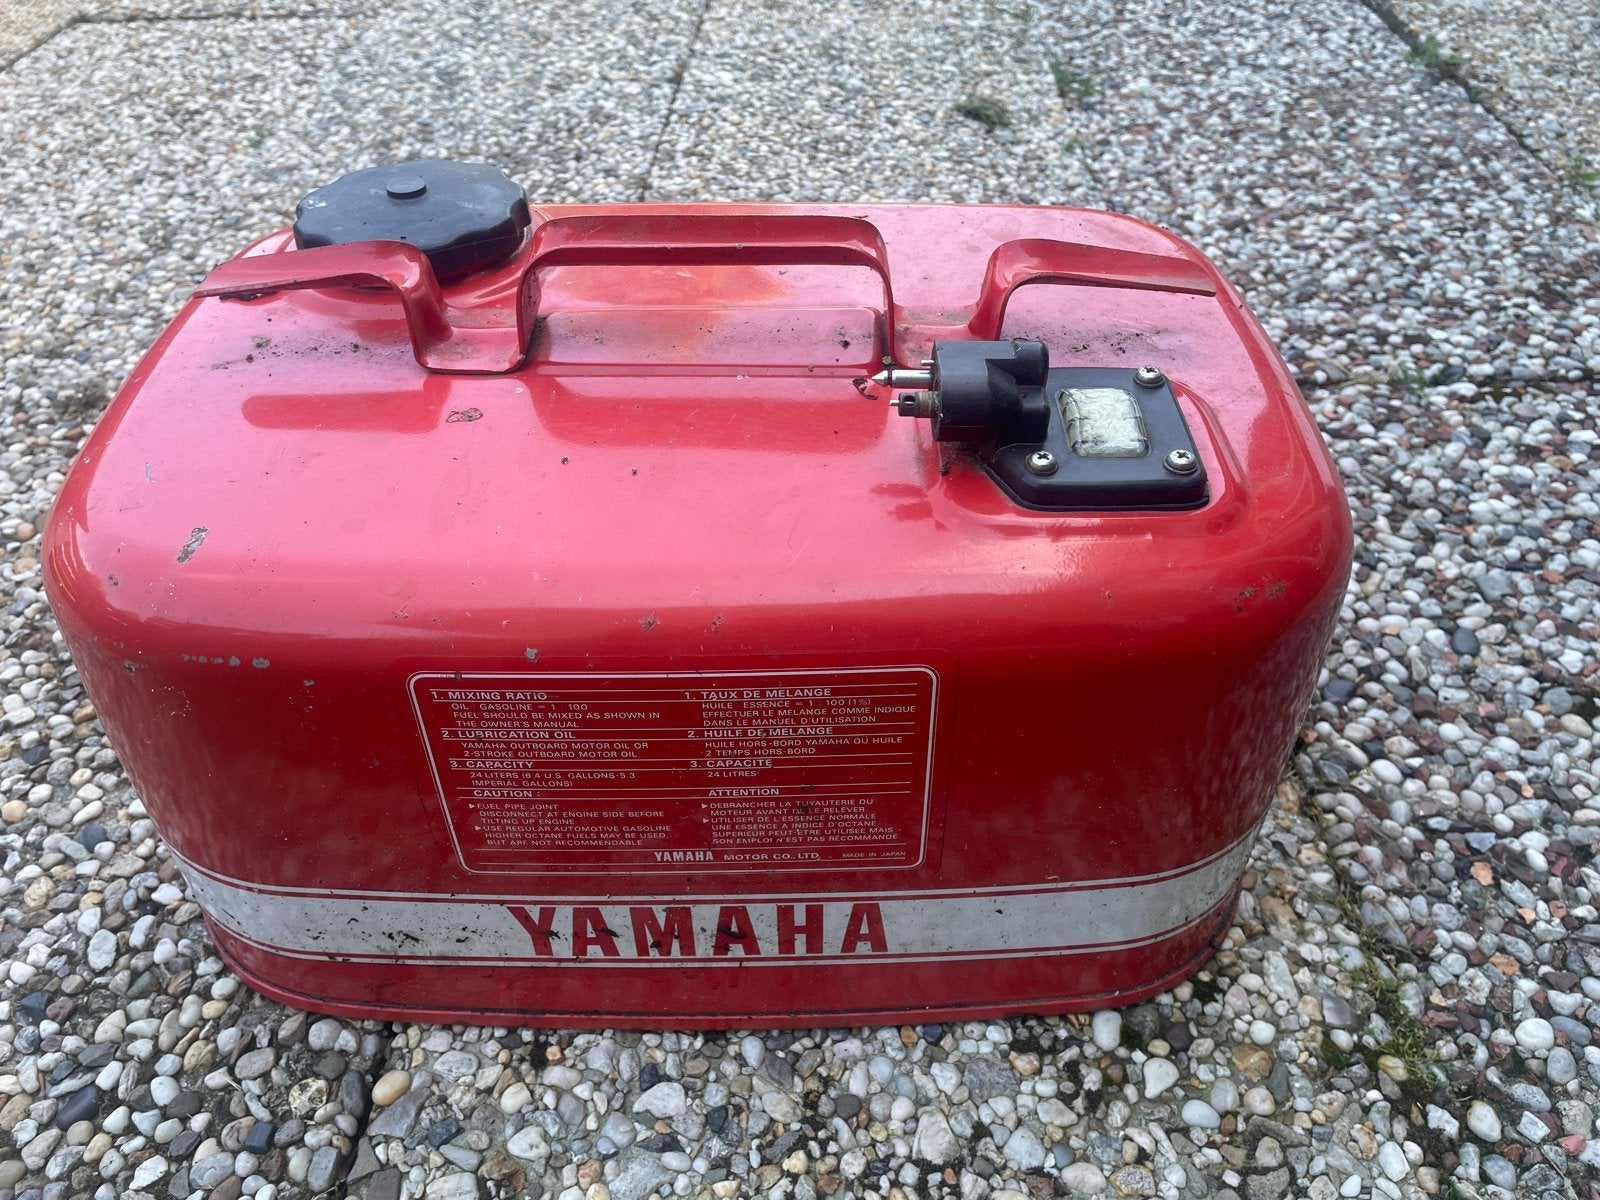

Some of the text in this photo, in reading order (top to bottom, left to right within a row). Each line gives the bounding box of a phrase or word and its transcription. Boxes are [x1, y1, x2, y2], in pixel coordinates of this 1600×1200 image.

[431, 691, 547, 700] 1. MIXING RATIO
[701, 691, 738, 699] TAUX
[743, 690, 761, 698] DE
[765, 688, 831, 698] MELANGE
[743, 700, 790, 709] ESSENCE
[848, 698, 871, 706] (1%)
[702, 710, 759, 718] EFFECTUER
[778, 708, 827, 716] MELANGE
[874, 705, 916, 713] INDIQUE
[480, 720, 530, 728] OWNER'S
[703, 719, 733, 727] DANS
[752, 718, 796, 726] MANUEL
[441, 730, 577, 739] 2. LUBRICATION OIL
[687, 727, 833, 738] 2. HUILE DE MELANGE
[805, 738, 850, 746] YAMAHA
[872, 736, 903, 744] HUILE
[510, 742, 567, 750] OUTBOARD
[571, 742, 611, 750] MOTOR
[613, 742, 631, 750] OIL
[633, 742, 649, 750] OR
[464, 750, 515, 758] 2-STROKE
[716, 749, 751, 757] TEMPS
[450, 760, 534, 769] 3. CAPACITY
[690, 760, 702, 768] 3.
[473, 790, 533, 798] CAUTION
[708, 788, 779, 796] ATTENTION
[710, 801, 776, 809] DEBRANCHER
[795, 799, 855, 807] TUYAUTERIE
[823, 806, 865, 814] RELEVER
[829, 813, 877, 821] NORMALE
[827, 820, 877, 828] D'OCTANE
[869, 826, 894, 834] MAIS
[828, 834, 898, 842] RECOMMANDE
[654, 851, 714, 861] YAMAHA
[724, 853, 769, 861] MOTOR
[506, 903, 889, 957] YAMAHA
